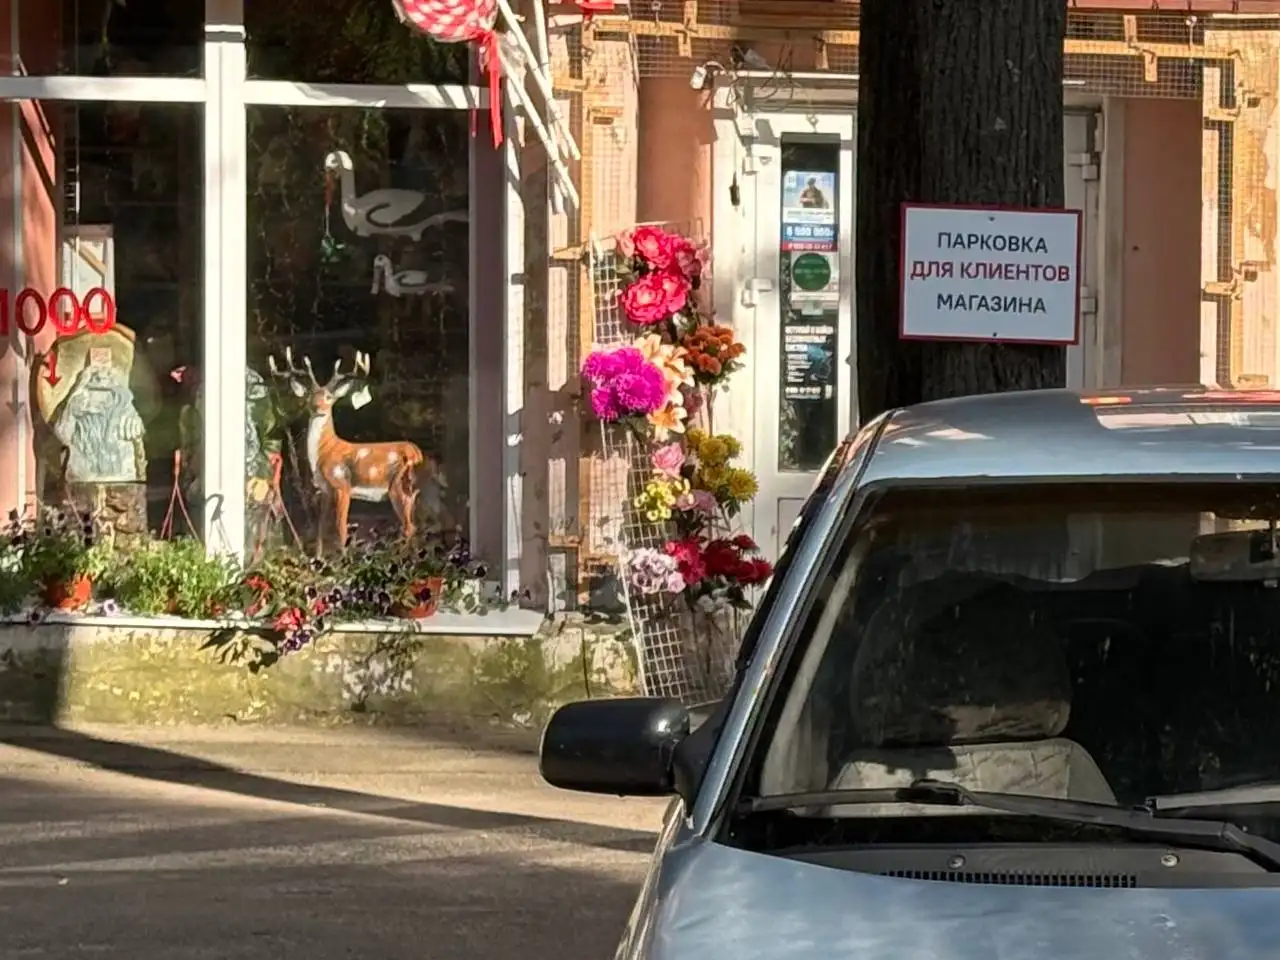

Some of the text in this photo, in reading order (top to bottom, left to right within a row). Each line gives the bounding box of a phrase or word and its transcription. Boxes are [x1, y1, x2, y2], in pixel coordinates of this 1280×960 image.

[937, 232, 1048, 254] ПАРКОВКА
[910, 260, 1070, 282] ДЛЯ КЛИЕНТОВ
[936, 293, 1046, 313] МАГАЗИНА
